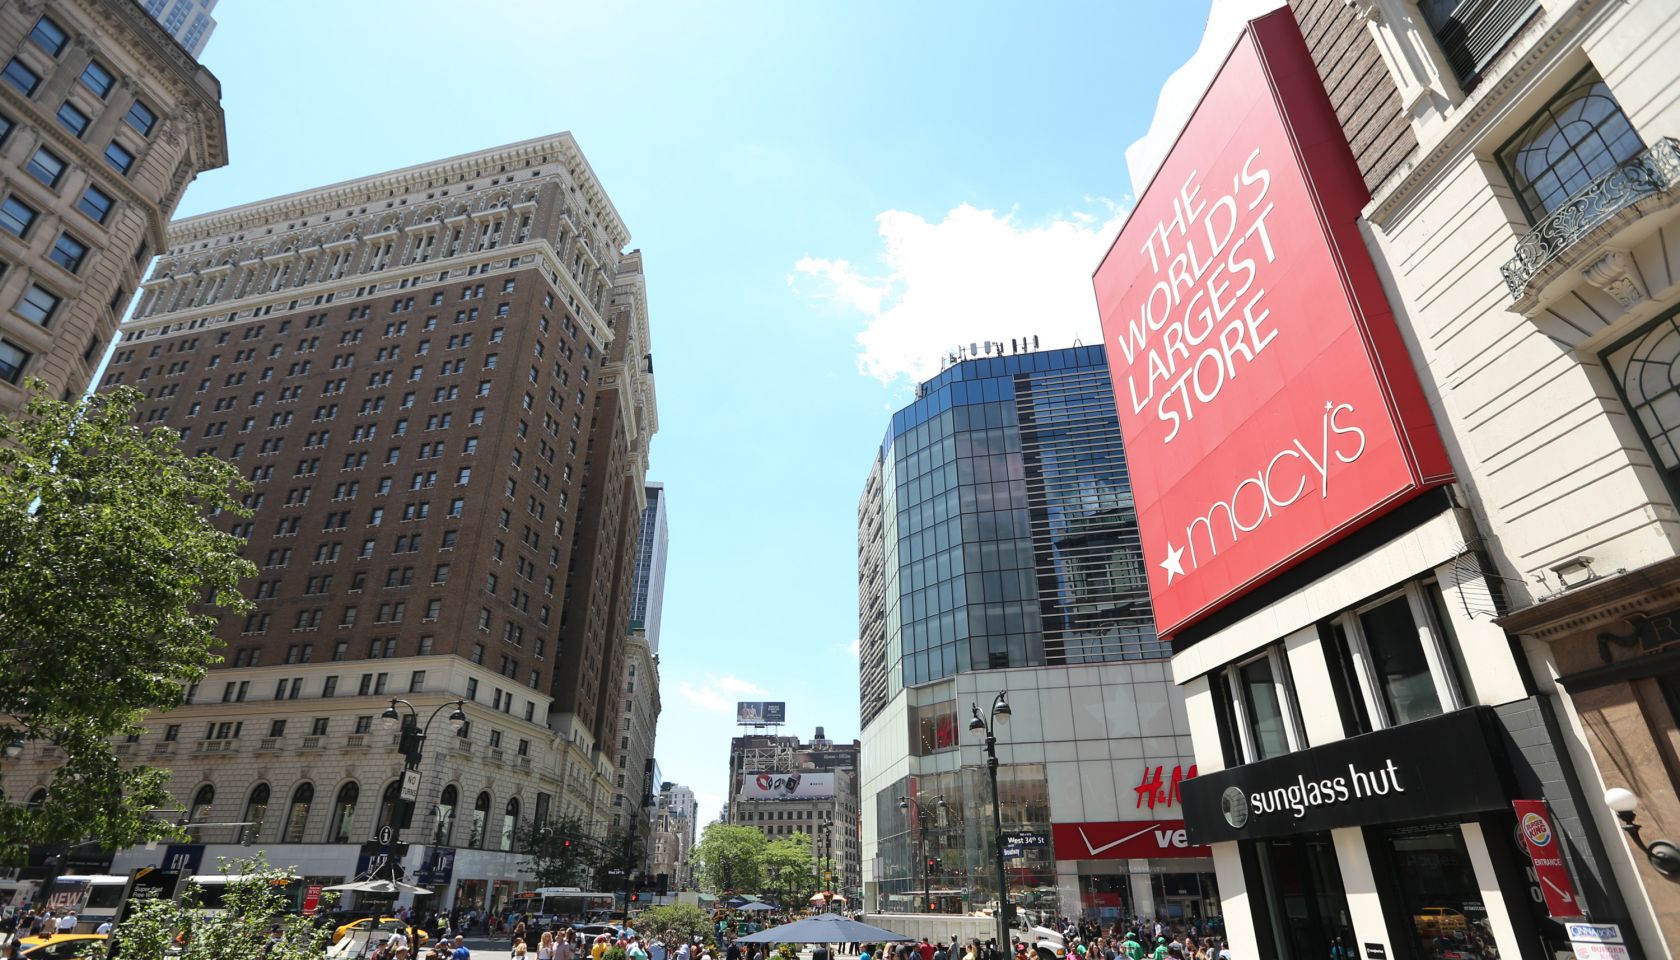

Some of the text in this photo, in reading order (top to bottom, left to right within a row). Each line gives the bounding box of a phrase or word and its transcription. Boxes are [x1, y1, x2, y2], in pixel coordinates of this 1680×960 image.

[1140, 169, 1207, 275] THE
[1118, 147, 1271, 366] WORLD'S
[1128, 201, 1276, 416] LARGEST
[1157, 288, 1279, 444] STORE
[407, 775, 416, 785] NO
[1251, 759, 1405, 818] sunglass hut
[1008, 836, 1024, 844] West
[1531, 825, 1547, 837] KING
[171, 854, 190, 870] GAP
[1534, 858, 1562, 867] ENTRANCE
[47, 891, 82, 910] NEW
